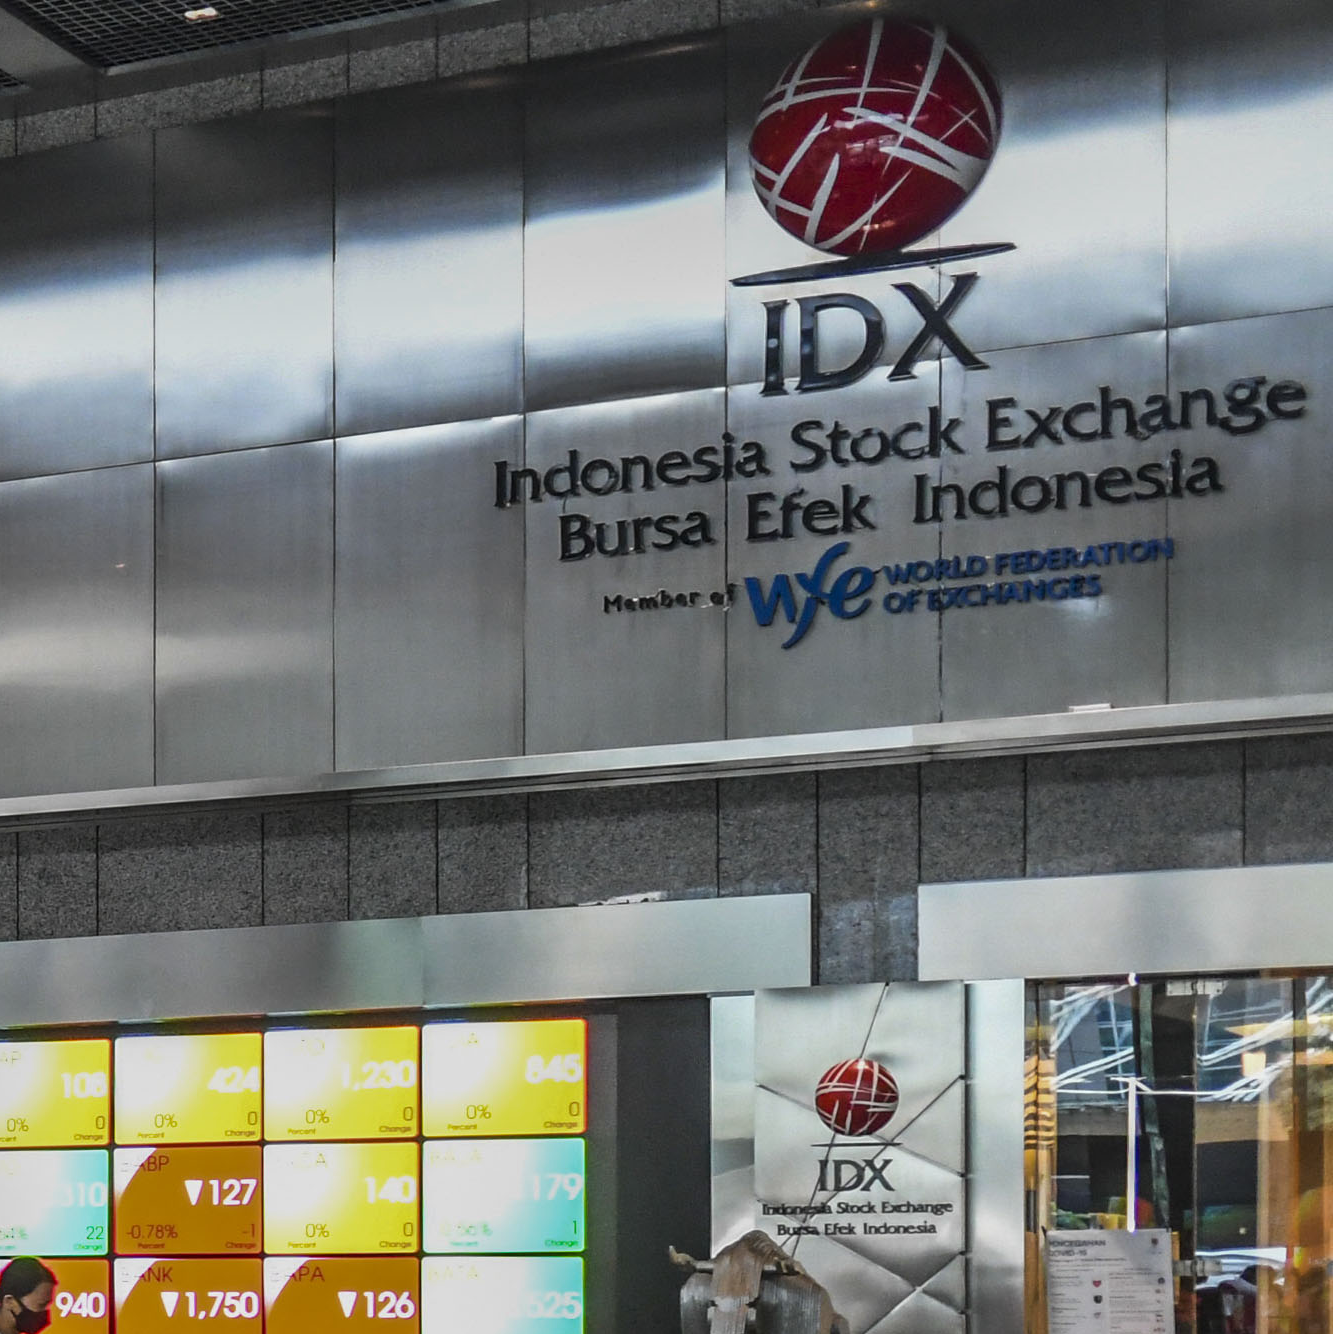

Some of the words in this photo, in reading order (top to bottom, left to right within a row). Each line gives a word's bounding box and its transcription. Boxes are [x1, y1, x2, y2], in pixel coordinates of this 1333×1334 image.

[760, 273, 990, 397] IDX
[493, 432, 768, 508] Indonesia
[789, 406, 964, 473] Stock
[986, 375, 1307, 452] Exchange
[558, 511, 717, 562] Bursa
[746, 485, 876, 543] Efek
[913, 450, 1224, 527] Indonesia
[882, 555, 989, 586] WORLD
[994, 537, 1174, 576] FEDERATION
[603, 588, 701, 614] Member
[709, 582, 739, 609] of
[883, 588, 924, 614] OF
[927, 574, 1102, 612] EXCHANGES
[524, 1054, 582, 1084] 845
[208, 1066, 260, 1093] 424
[154, 1113, 178, 1128] 0%
[247, 1111, 258, 1126] 0
[305, 1109, 330, 1124] 0%
[403, 1106, 414, 1122] 0
[466, 1104, 491, 1120] 0%
[568, 1101, 580, 1117] 0
[7, 1118, 30, 1132] 0%
[96, 1115, 106, 1130] 0
[379, 1125, 412, 1133] Change
[543, 1120, 578, 1129] Change
[818, 1159, 895, 1192] IDX
[209, 1178, 258, 1206] 127
[364, 1175, 416, 1204] 140
[762, 1202, 832, 1216] Indonesia
[836, 1201, 876, 1214] Stock
[881, 1201, 953, 1216] Exchange
[86, 1225, 105, 1240] 22
[126, 1224, 178, 1239] -0.78%
[242, 1223, 256, 1238] -1
[305, 1223, 330, 1238] 0%
[403, 1222, 414, 1237] 0
[571, 1220, 578, 1235] 1
[777, 1224, 820, 1236] Bursa
[824, 1223, 856, 1236] Efek
[864, 1220, 937, 1235] Indonesia
[224, 1241, 256, 1249] Change
[379, 1240, 412, 1248] Change
[544, 1239, 579, 1247] Change
[55, 1291, 106, 1318] 940
[184, 1291, 260, 1320] 1,750
[363, 1290, 416, 1319] 126
